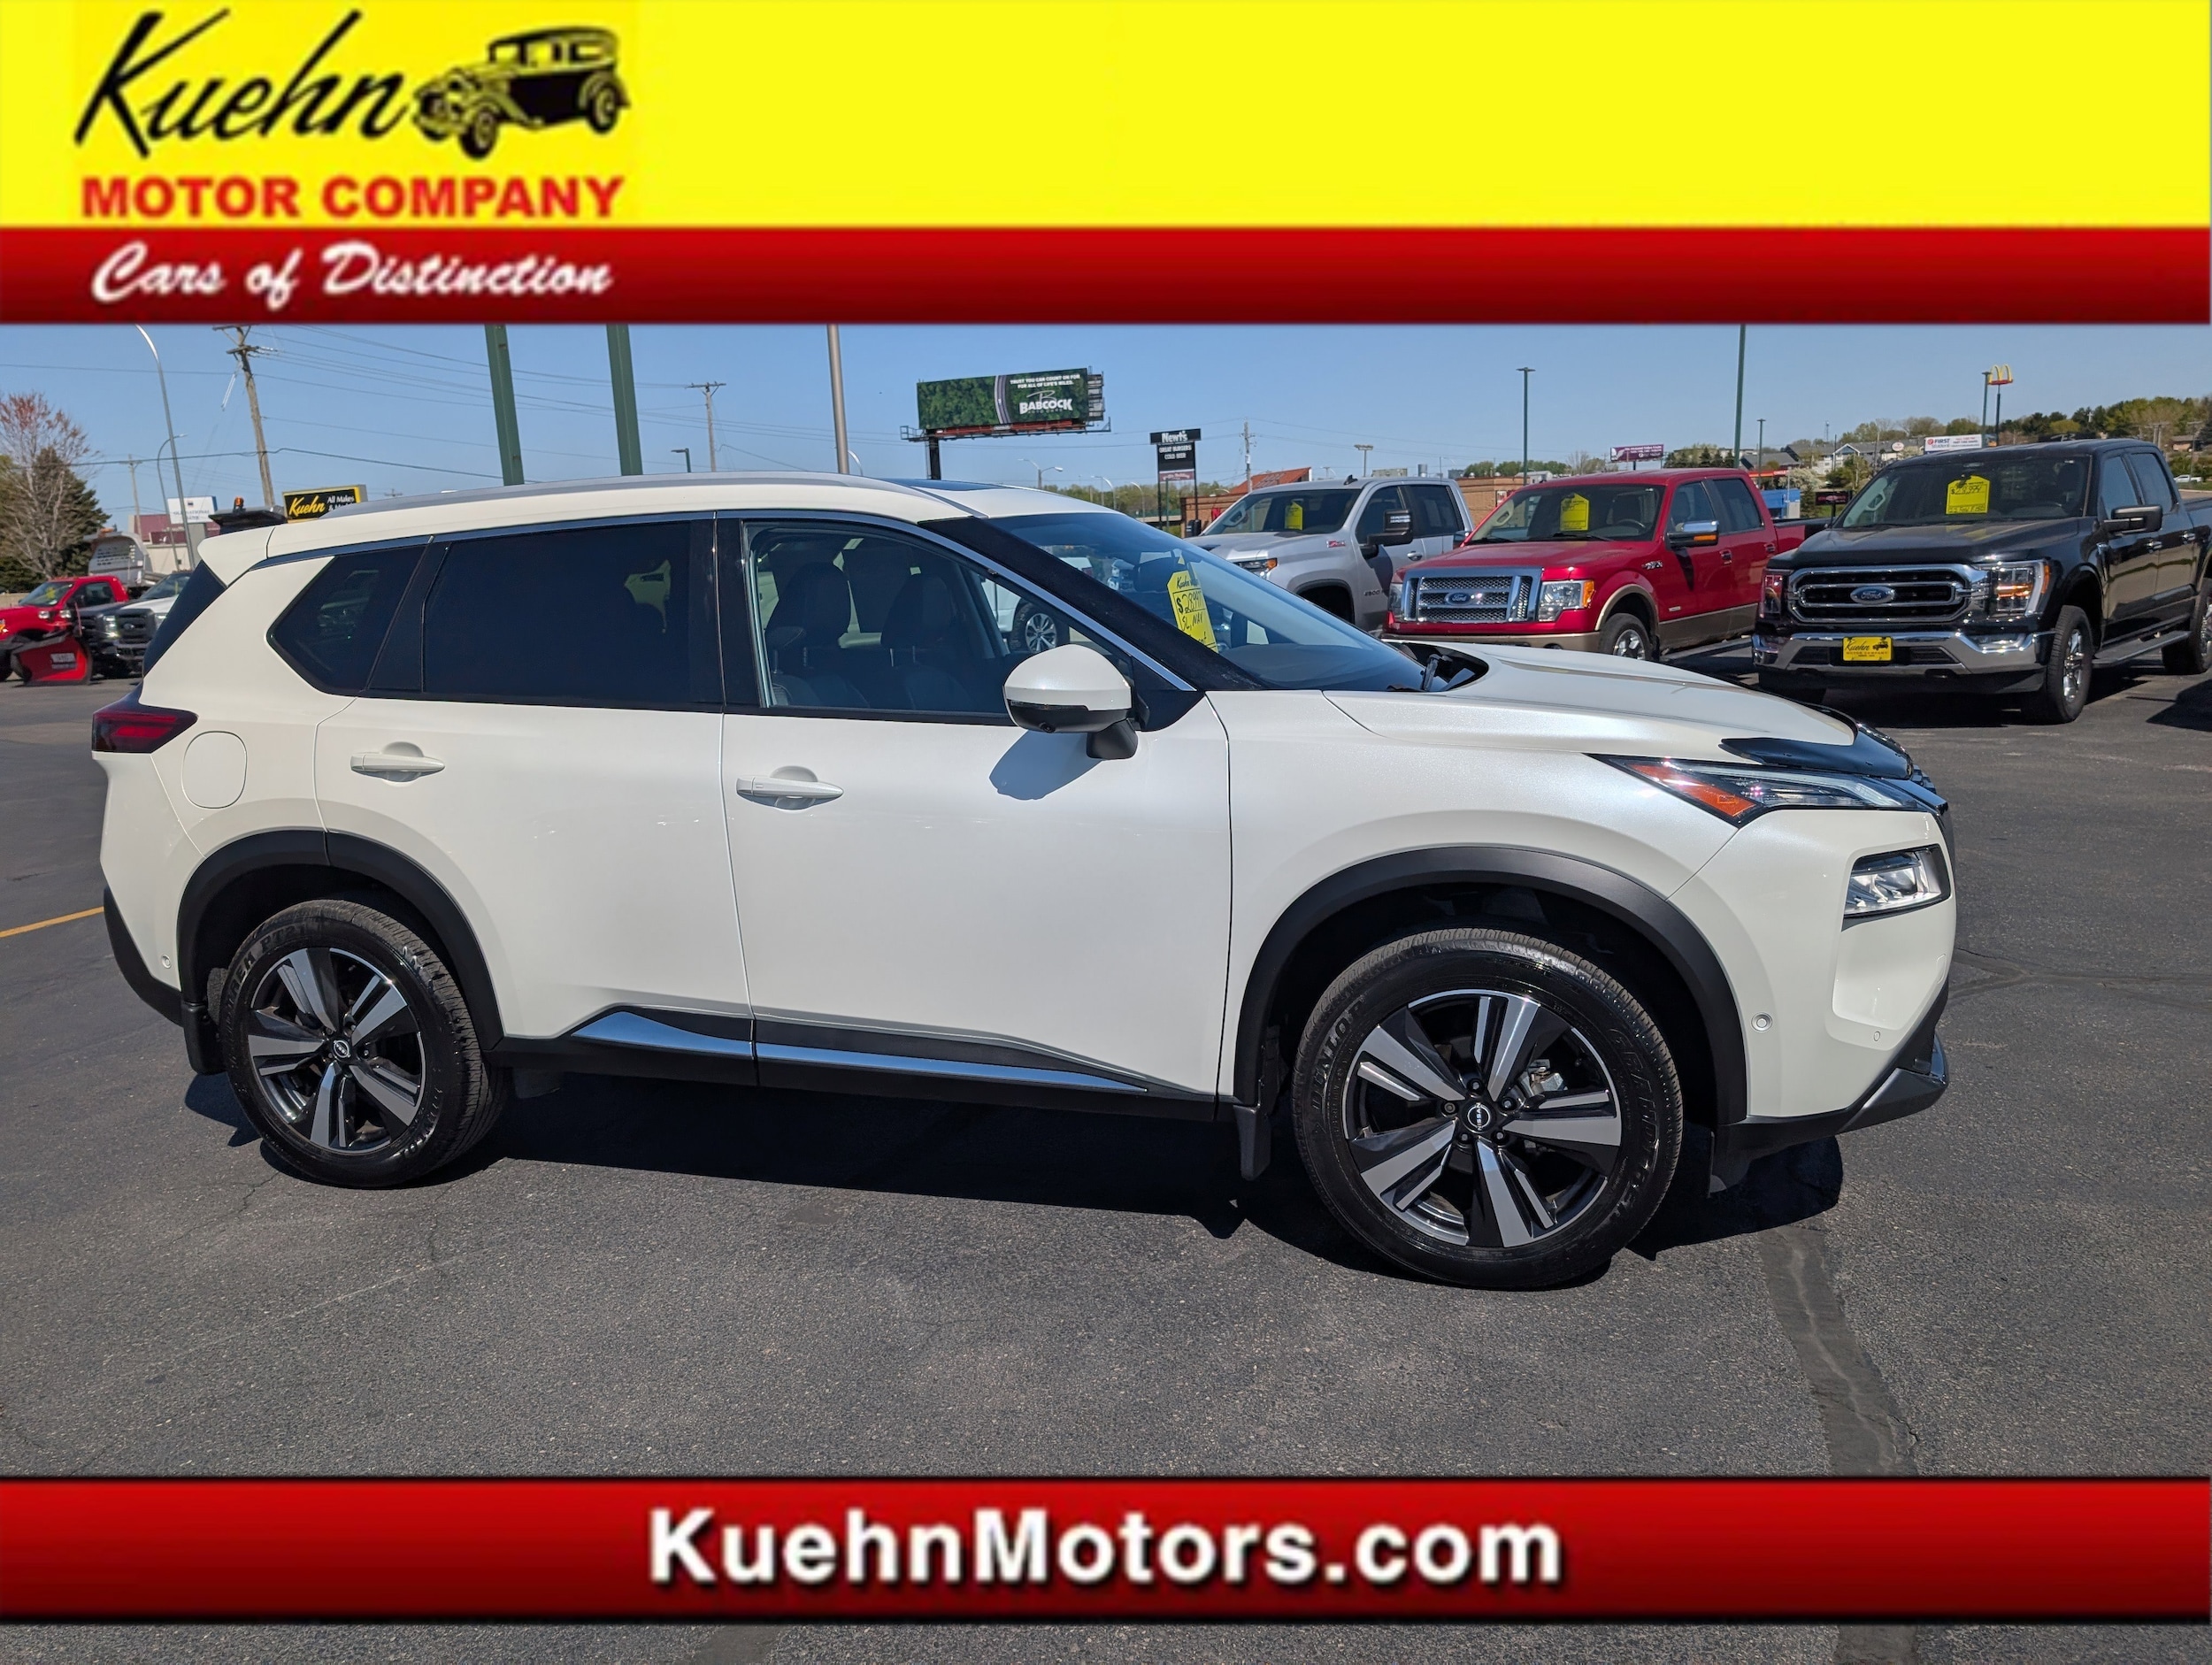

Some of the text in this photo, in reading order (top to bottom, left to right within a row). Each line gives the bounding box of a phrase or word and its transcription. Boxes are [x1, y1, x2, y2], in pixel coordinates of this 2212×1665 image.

[1019, 399, 1073, 414] BABCOCK
[1161, 430, 1188, 443] Newt's
[337, 495, 354, 503] Makes
[289, 495, 325, 517] Kuehn
[1861, 590, 1882, 600] Ford
[1845, 638, 1870, 651] Kuehn
